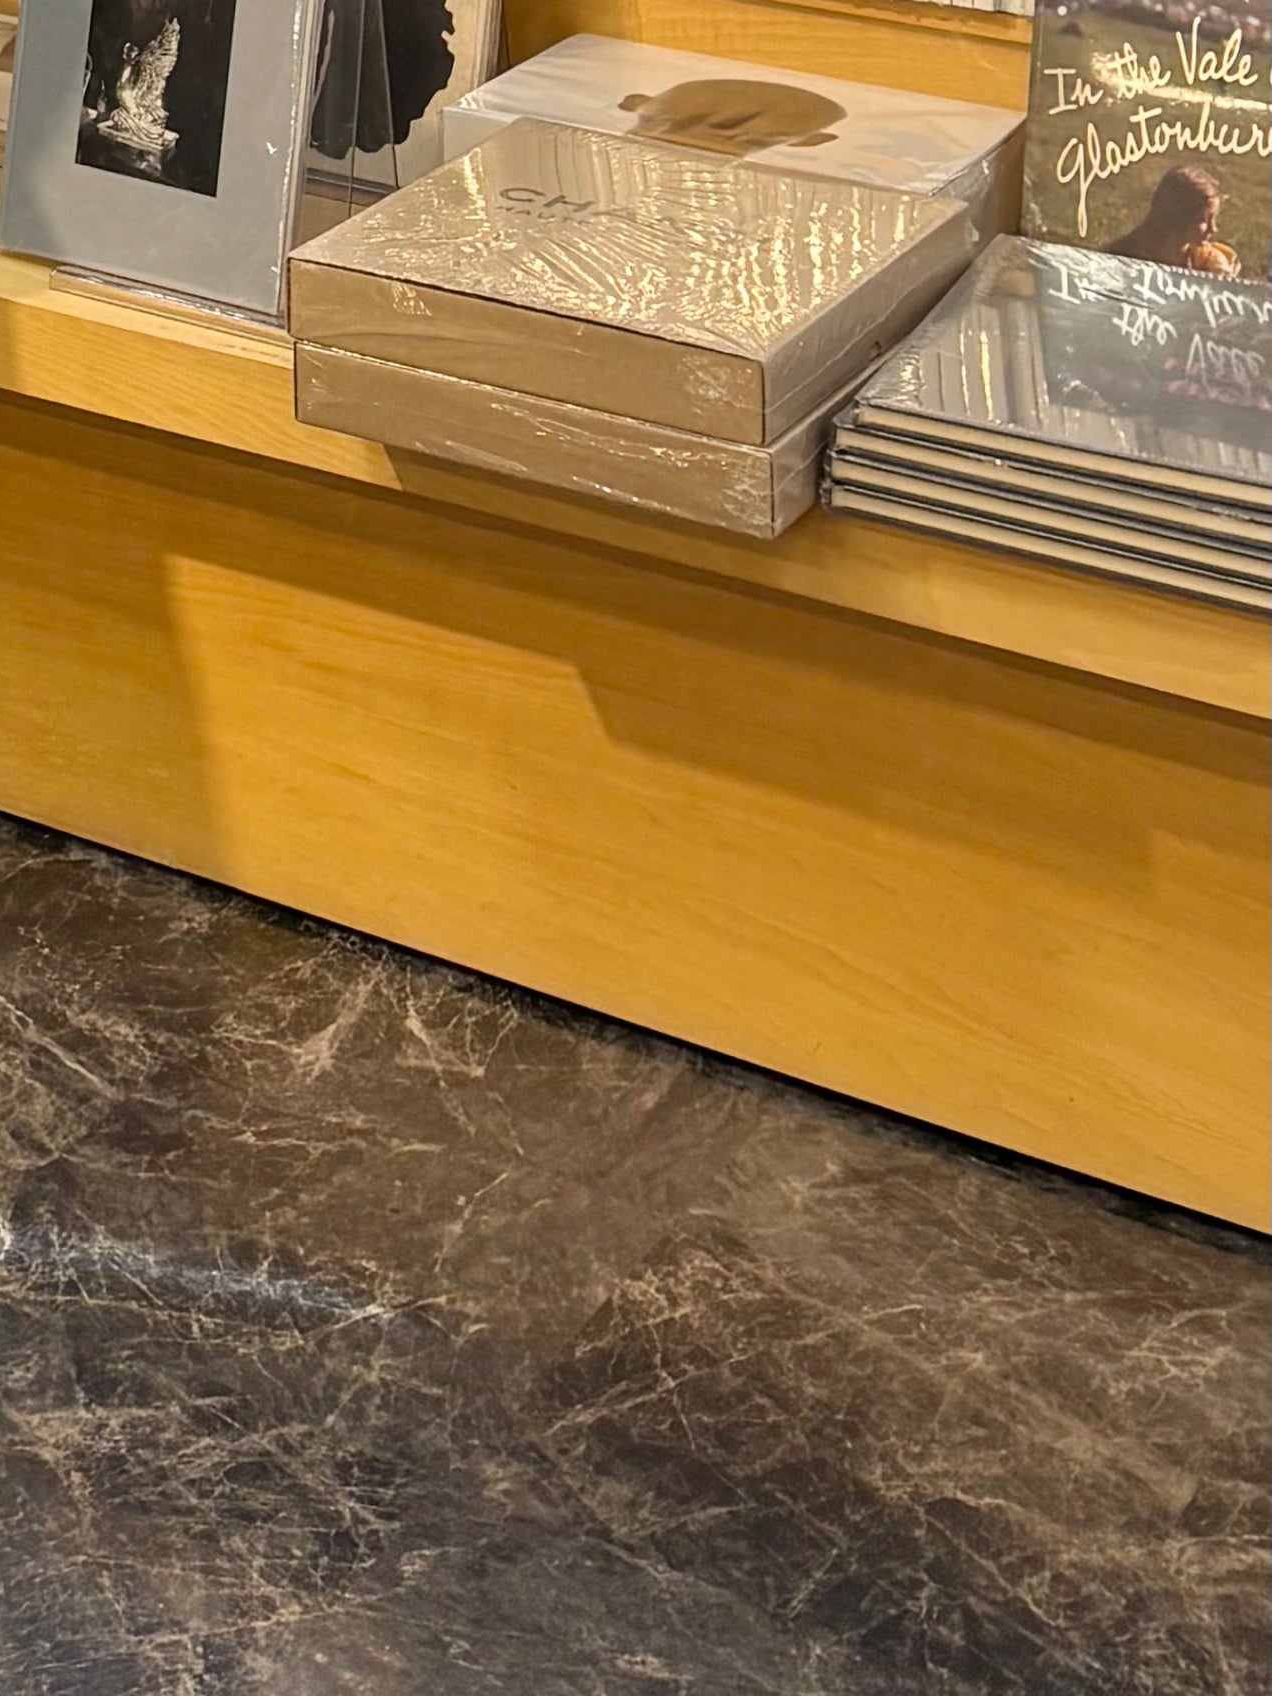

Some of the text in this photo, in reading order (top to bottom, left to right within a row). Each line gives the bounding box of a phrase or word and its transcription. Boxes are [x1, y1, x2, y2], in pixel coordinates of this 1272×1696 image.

[1044, 15, 1259, 114] In the Vale
